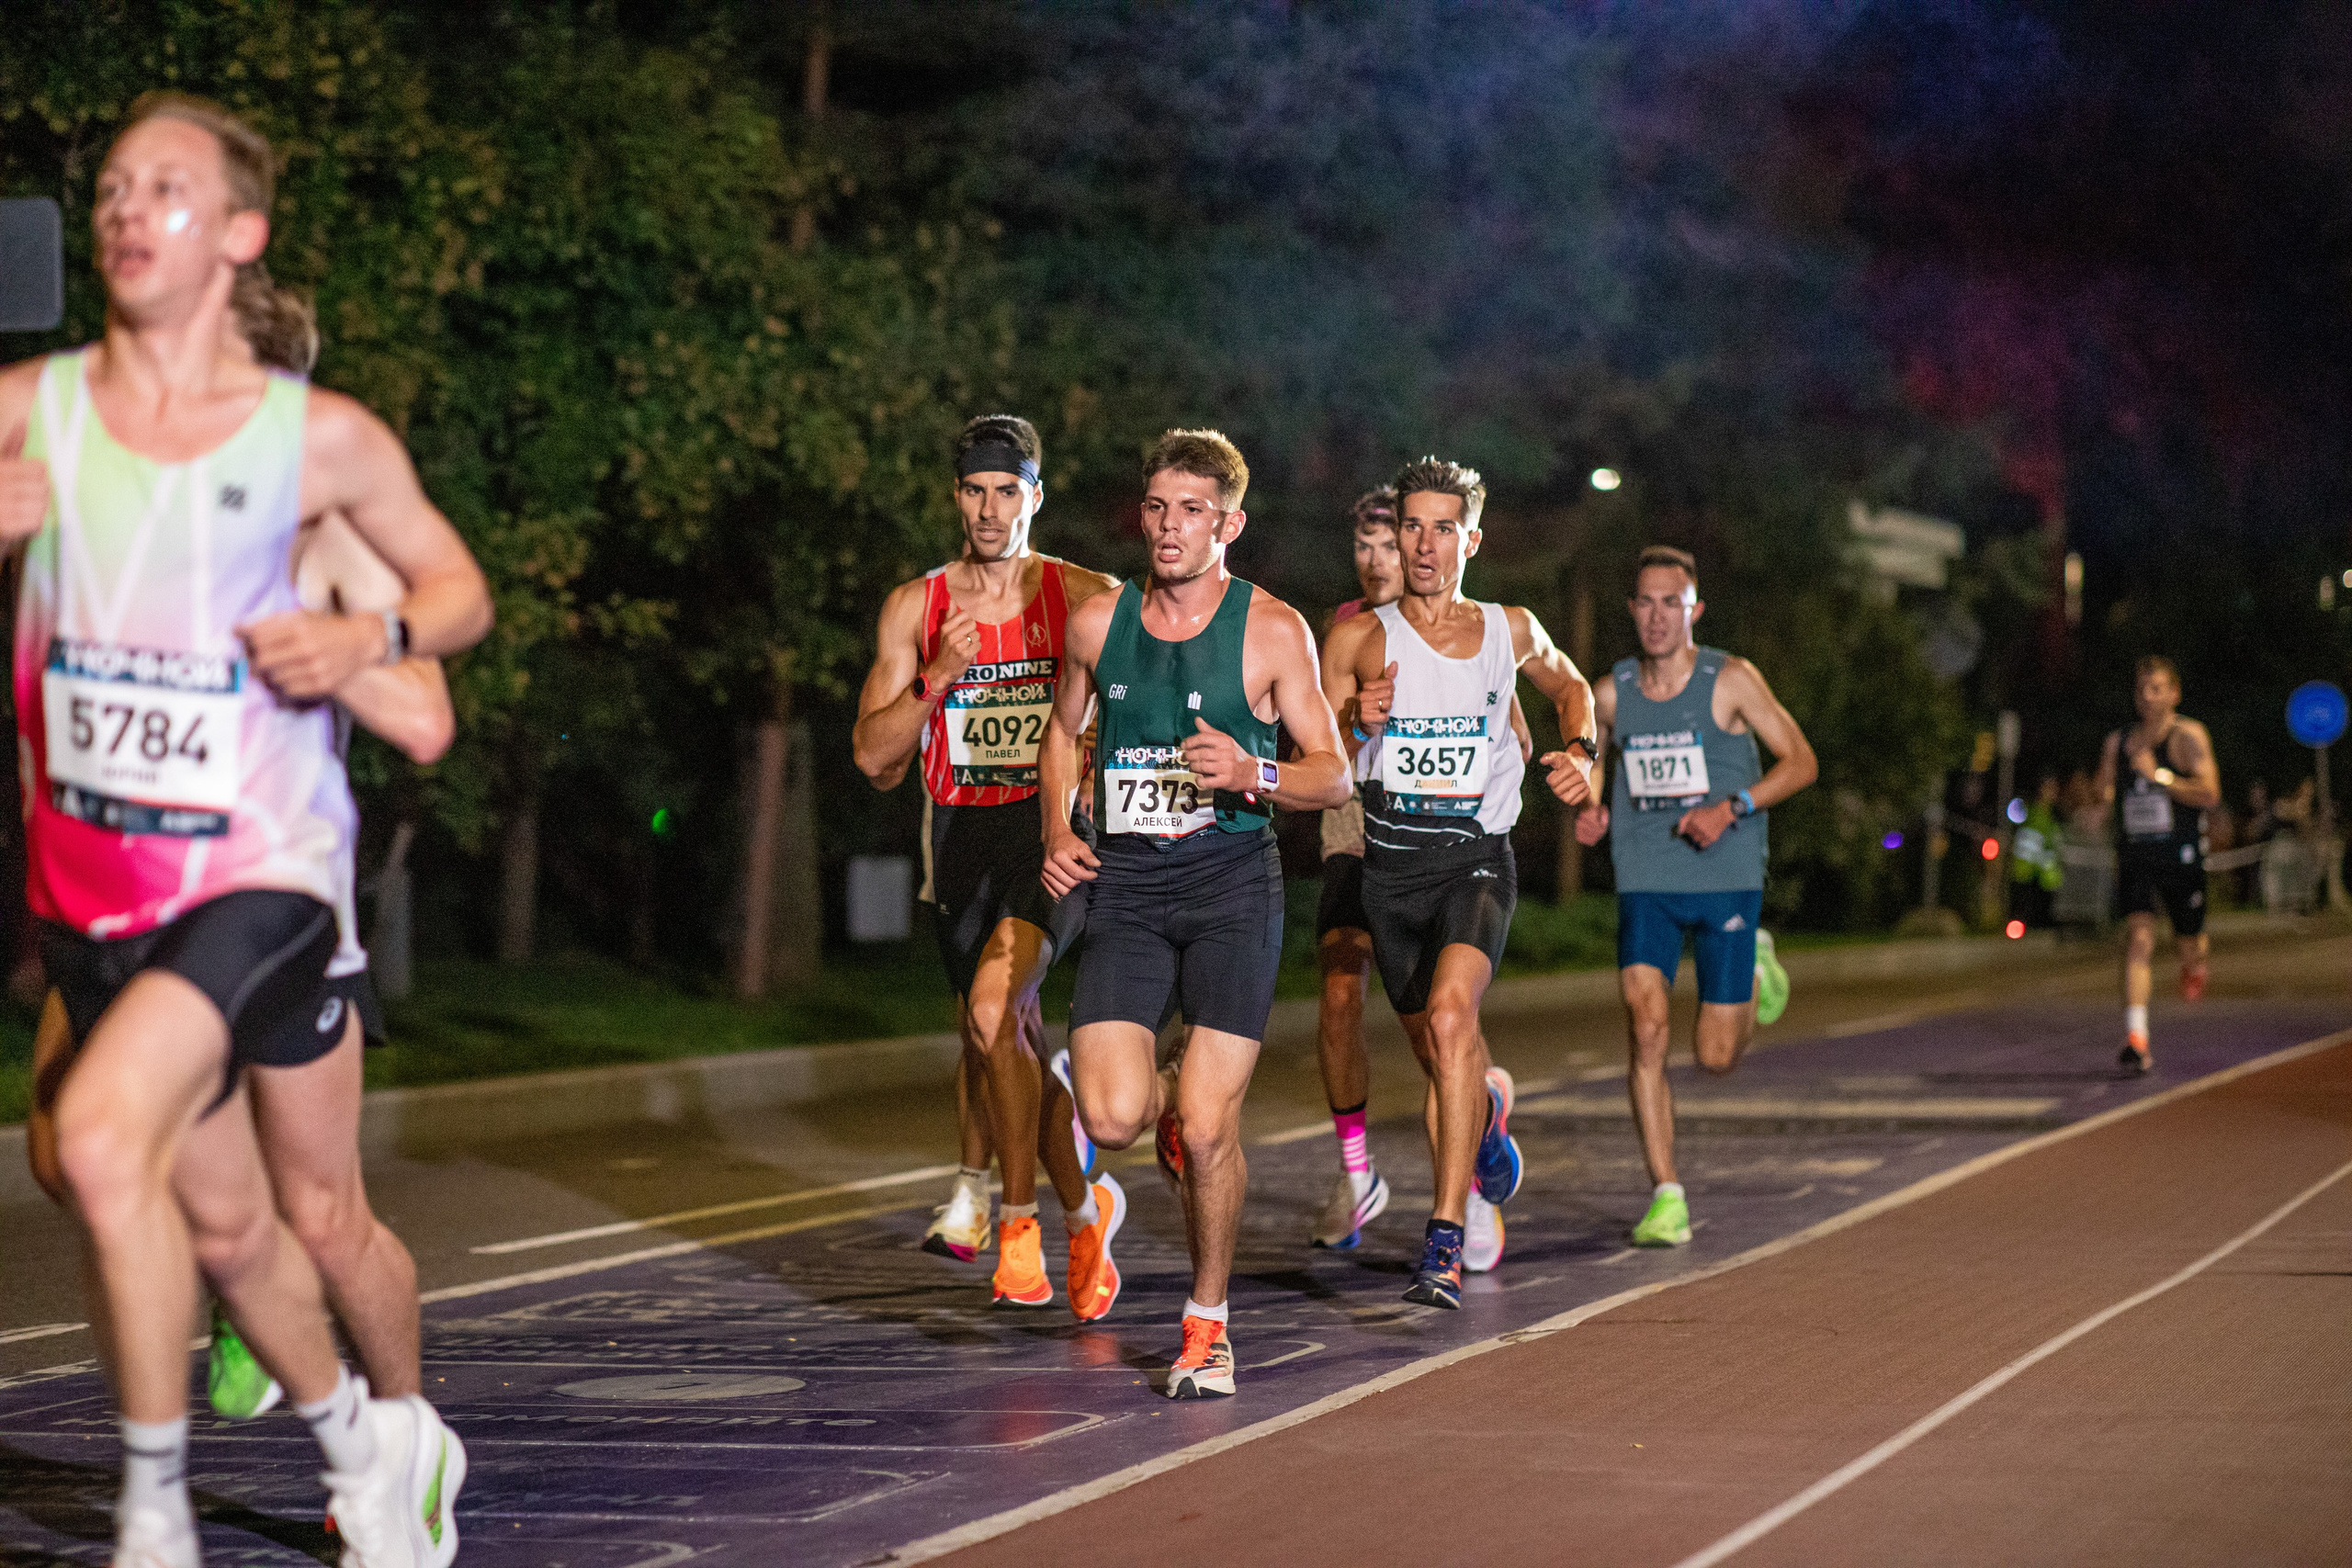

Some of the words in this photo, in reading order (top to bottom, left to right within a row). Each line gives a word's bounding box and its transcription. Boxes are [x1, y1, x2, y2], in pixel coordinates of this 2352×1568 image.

[963, 667, 994, 682] RO
[998, 660, 1053, 679] NINE
[955, 683, 1047, 705] НОЧНОЙ
[69, 696, 209, 765] 5784
[962, 714, 1042, 747] 4092
[1396, 716, 1480, 734] НОЧНОЙ
[986, 749, 1021, 759] ПАВЕЛ
[1114, 746, 1191, 766] НОЧНО
[1396, 746, 1476, 776] 3657
[1637, 755, 1692, 782] 1871
[1117, 779, 1199, 815] 7373
[1133, 816, 1183, 828] АЛЕКСЕЙ
[441, 1413, 878, 1427] оменяйте
